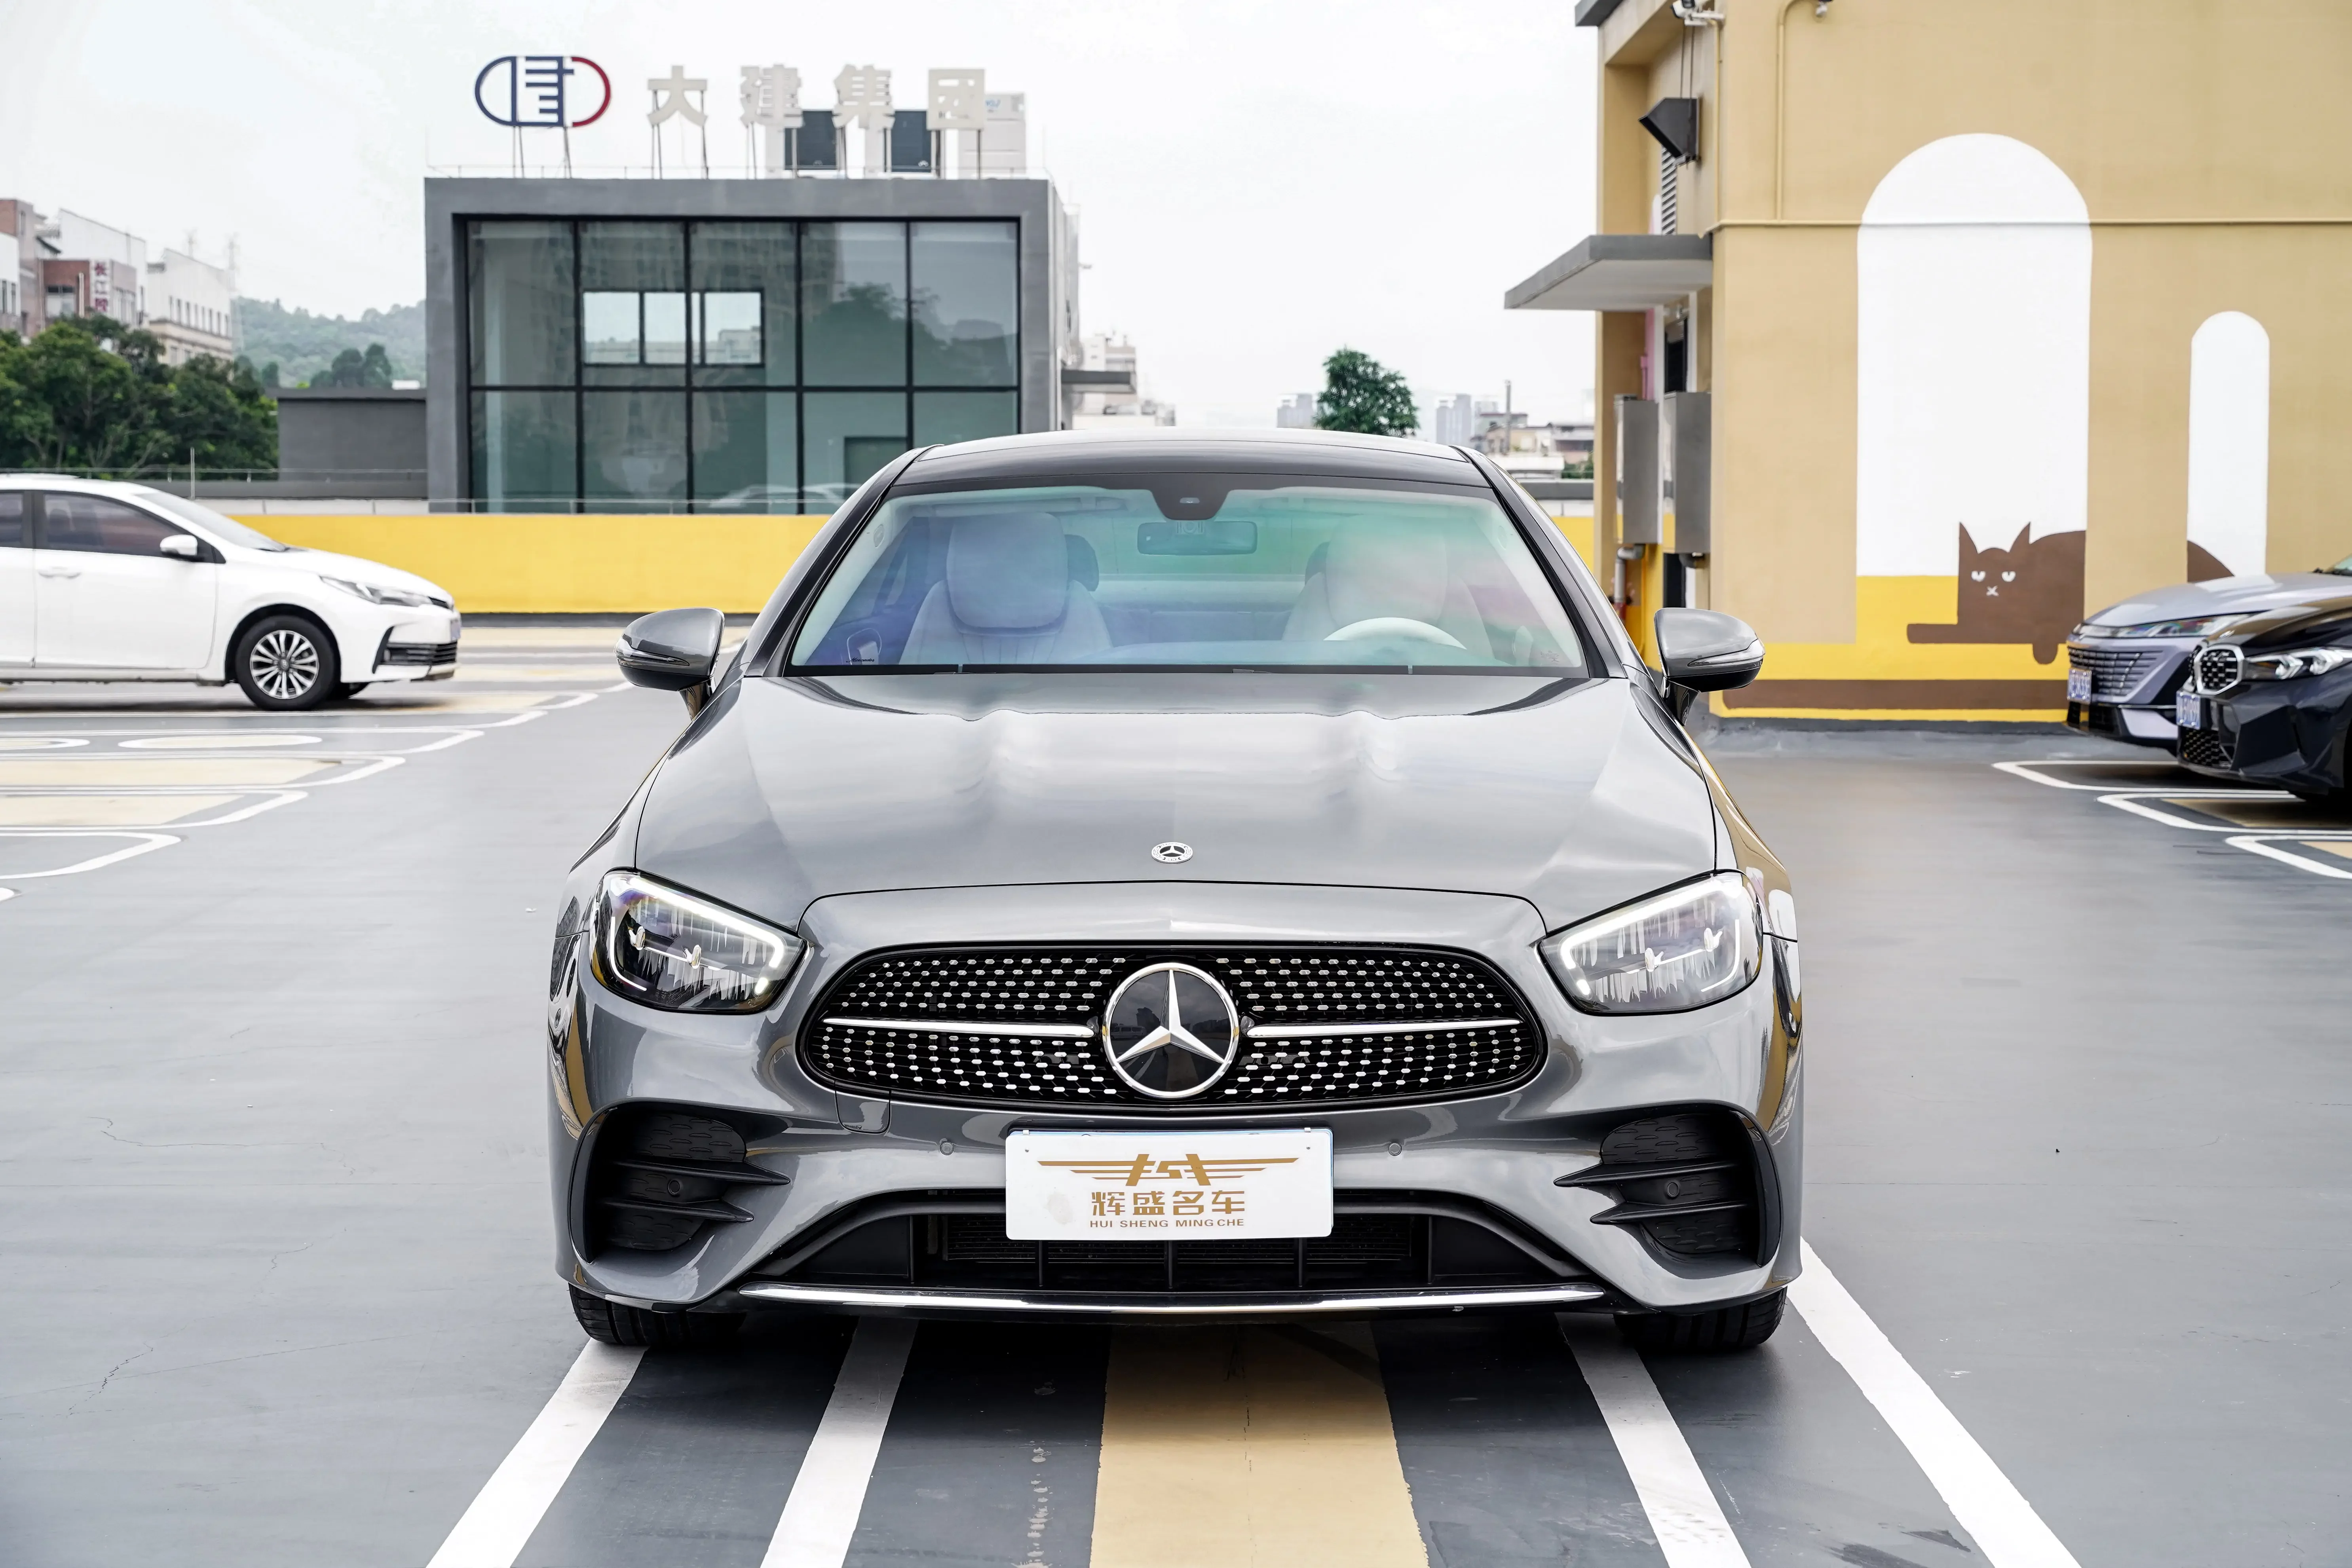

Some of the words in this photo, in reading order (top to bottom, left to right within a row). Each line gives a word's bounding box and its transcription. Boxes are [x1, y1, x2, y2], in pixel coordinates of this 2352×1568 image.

[646, 64, 985, 130] 大建集团
[1091, 1190, 1245, 1216] 辉盛名车
